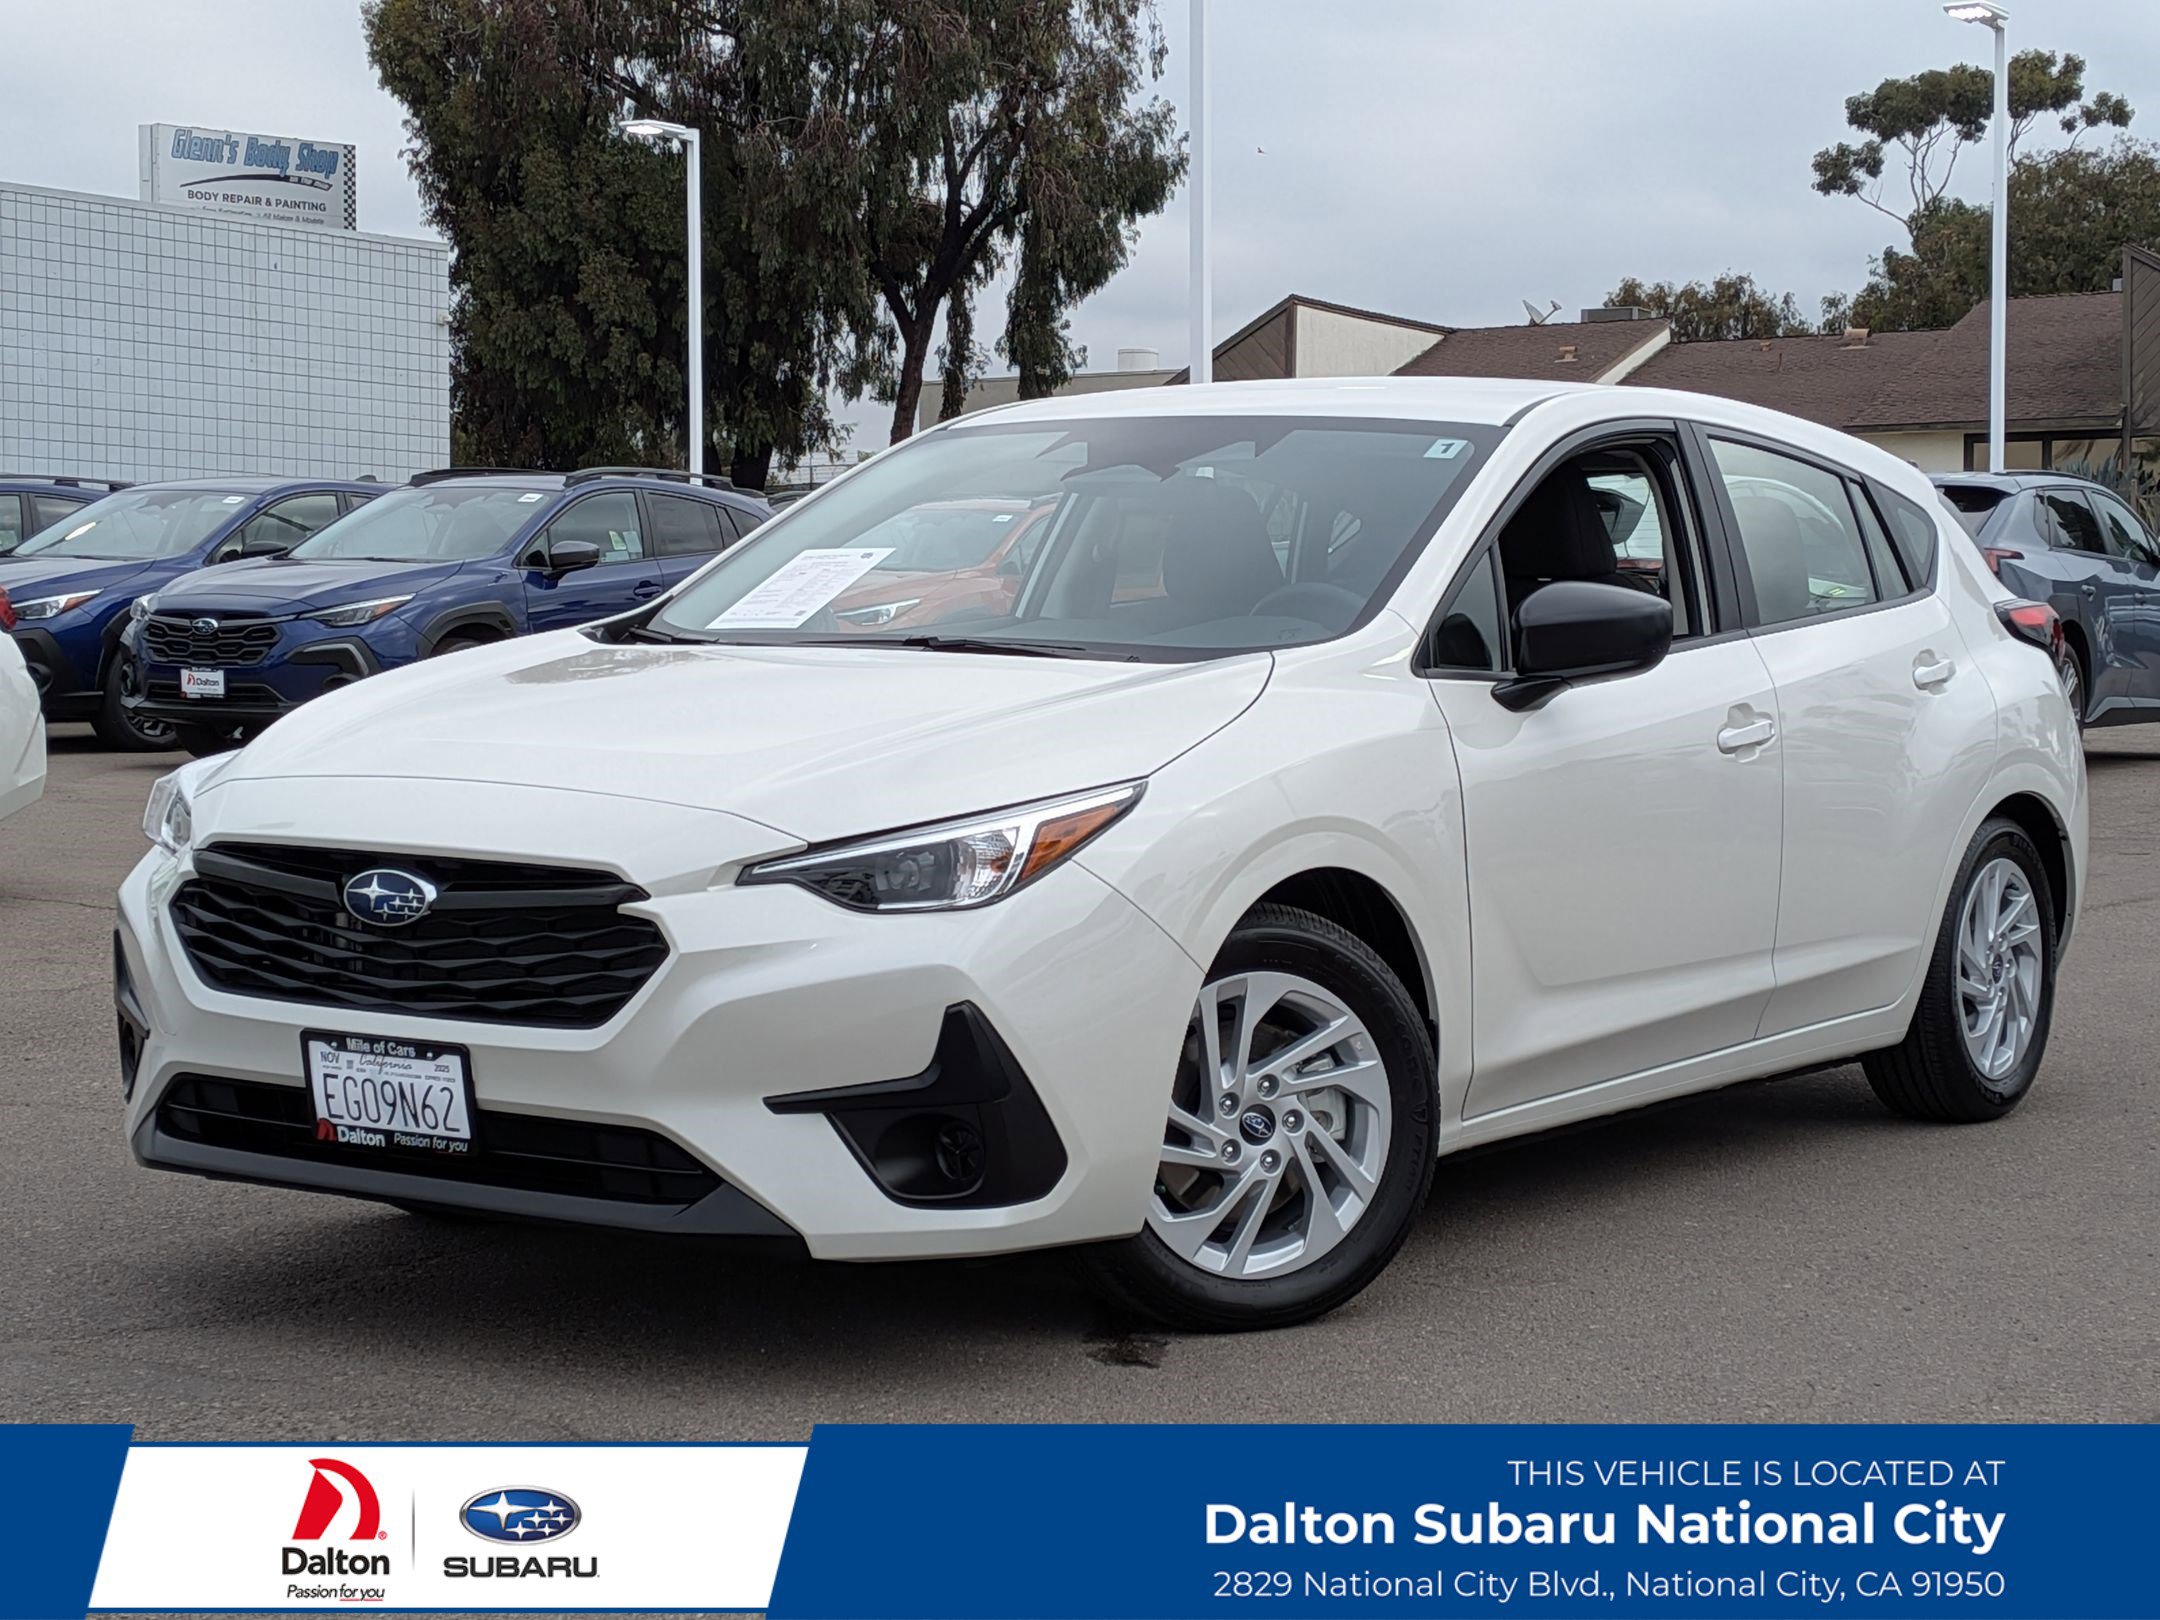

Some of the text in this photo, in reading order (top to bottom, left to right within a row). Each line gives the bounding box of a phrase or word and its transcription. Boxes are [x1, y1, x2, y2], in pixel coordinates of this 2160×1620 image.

[171, 128, 339, 179] Glenn's Body Shop
[187, 189, 327, 212] BODY REPAIR & PAINTING
[320, 1051, 340, 1064] NOV
[346, 1037, 416, 1058] Mile of Cars
[359, 1053, 412, 1075] California
[323, 1073, 460, 1132] EG09N62
[337, 1126, 468, 1153] Dalton Passion for you
[1440, 1442, 1455, 1454] 1
